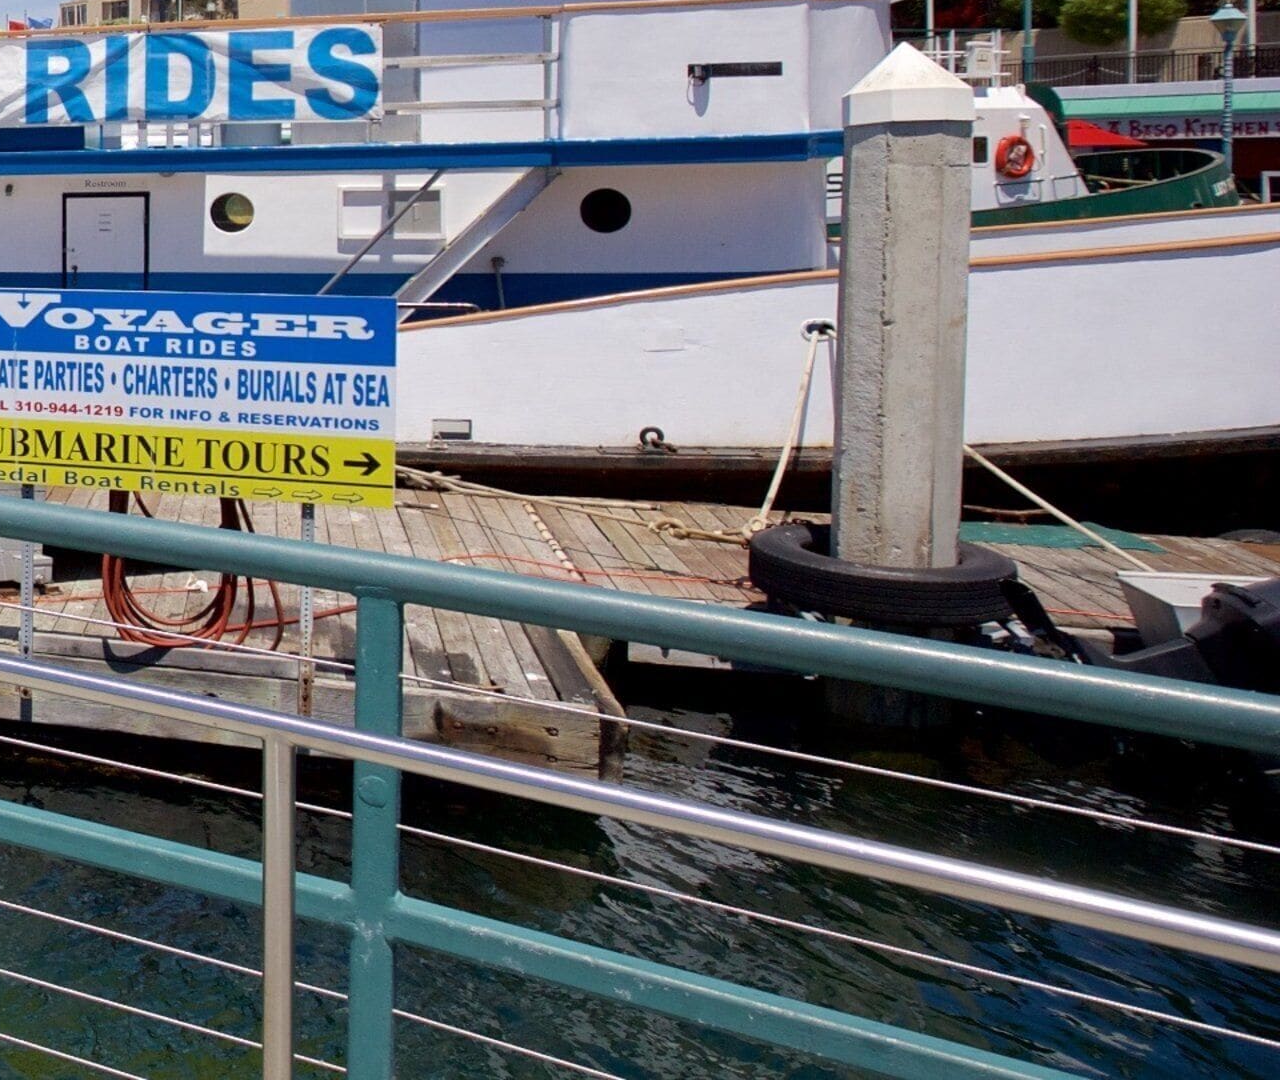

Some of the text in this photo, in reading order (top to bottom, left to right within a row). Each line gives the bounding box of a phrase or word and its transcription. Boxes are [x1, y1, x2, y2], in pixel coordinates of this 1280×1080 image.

[25, 26, 381, 124] RIDES
[1184, 117, 1269, 138] KITHEN
[85, 180, 127, 188] Restroom
[75, 335, 257, 357] BOAT RIDES
[34, 360, 105, 394] PARTIES
[123, 363, 218, 399] CHARTERS
[237, 369, 317, 404] BURIALS
[322, 372, 347, 405] AT
[352, 374, 390, 407] SEA
[14, 400, 124, 417] 310-944-1219
[129, 406, 164, 420] FOR
[170, 408, 212, 422] INFO
[218, 411, 231, 423] &
[238, 412, 380, 431] RESERVATIONS
[196, 438, 330, 477] TOURS
[64, 471, 122, 489] Boat
[140, 475, 240, 497] Rentals
